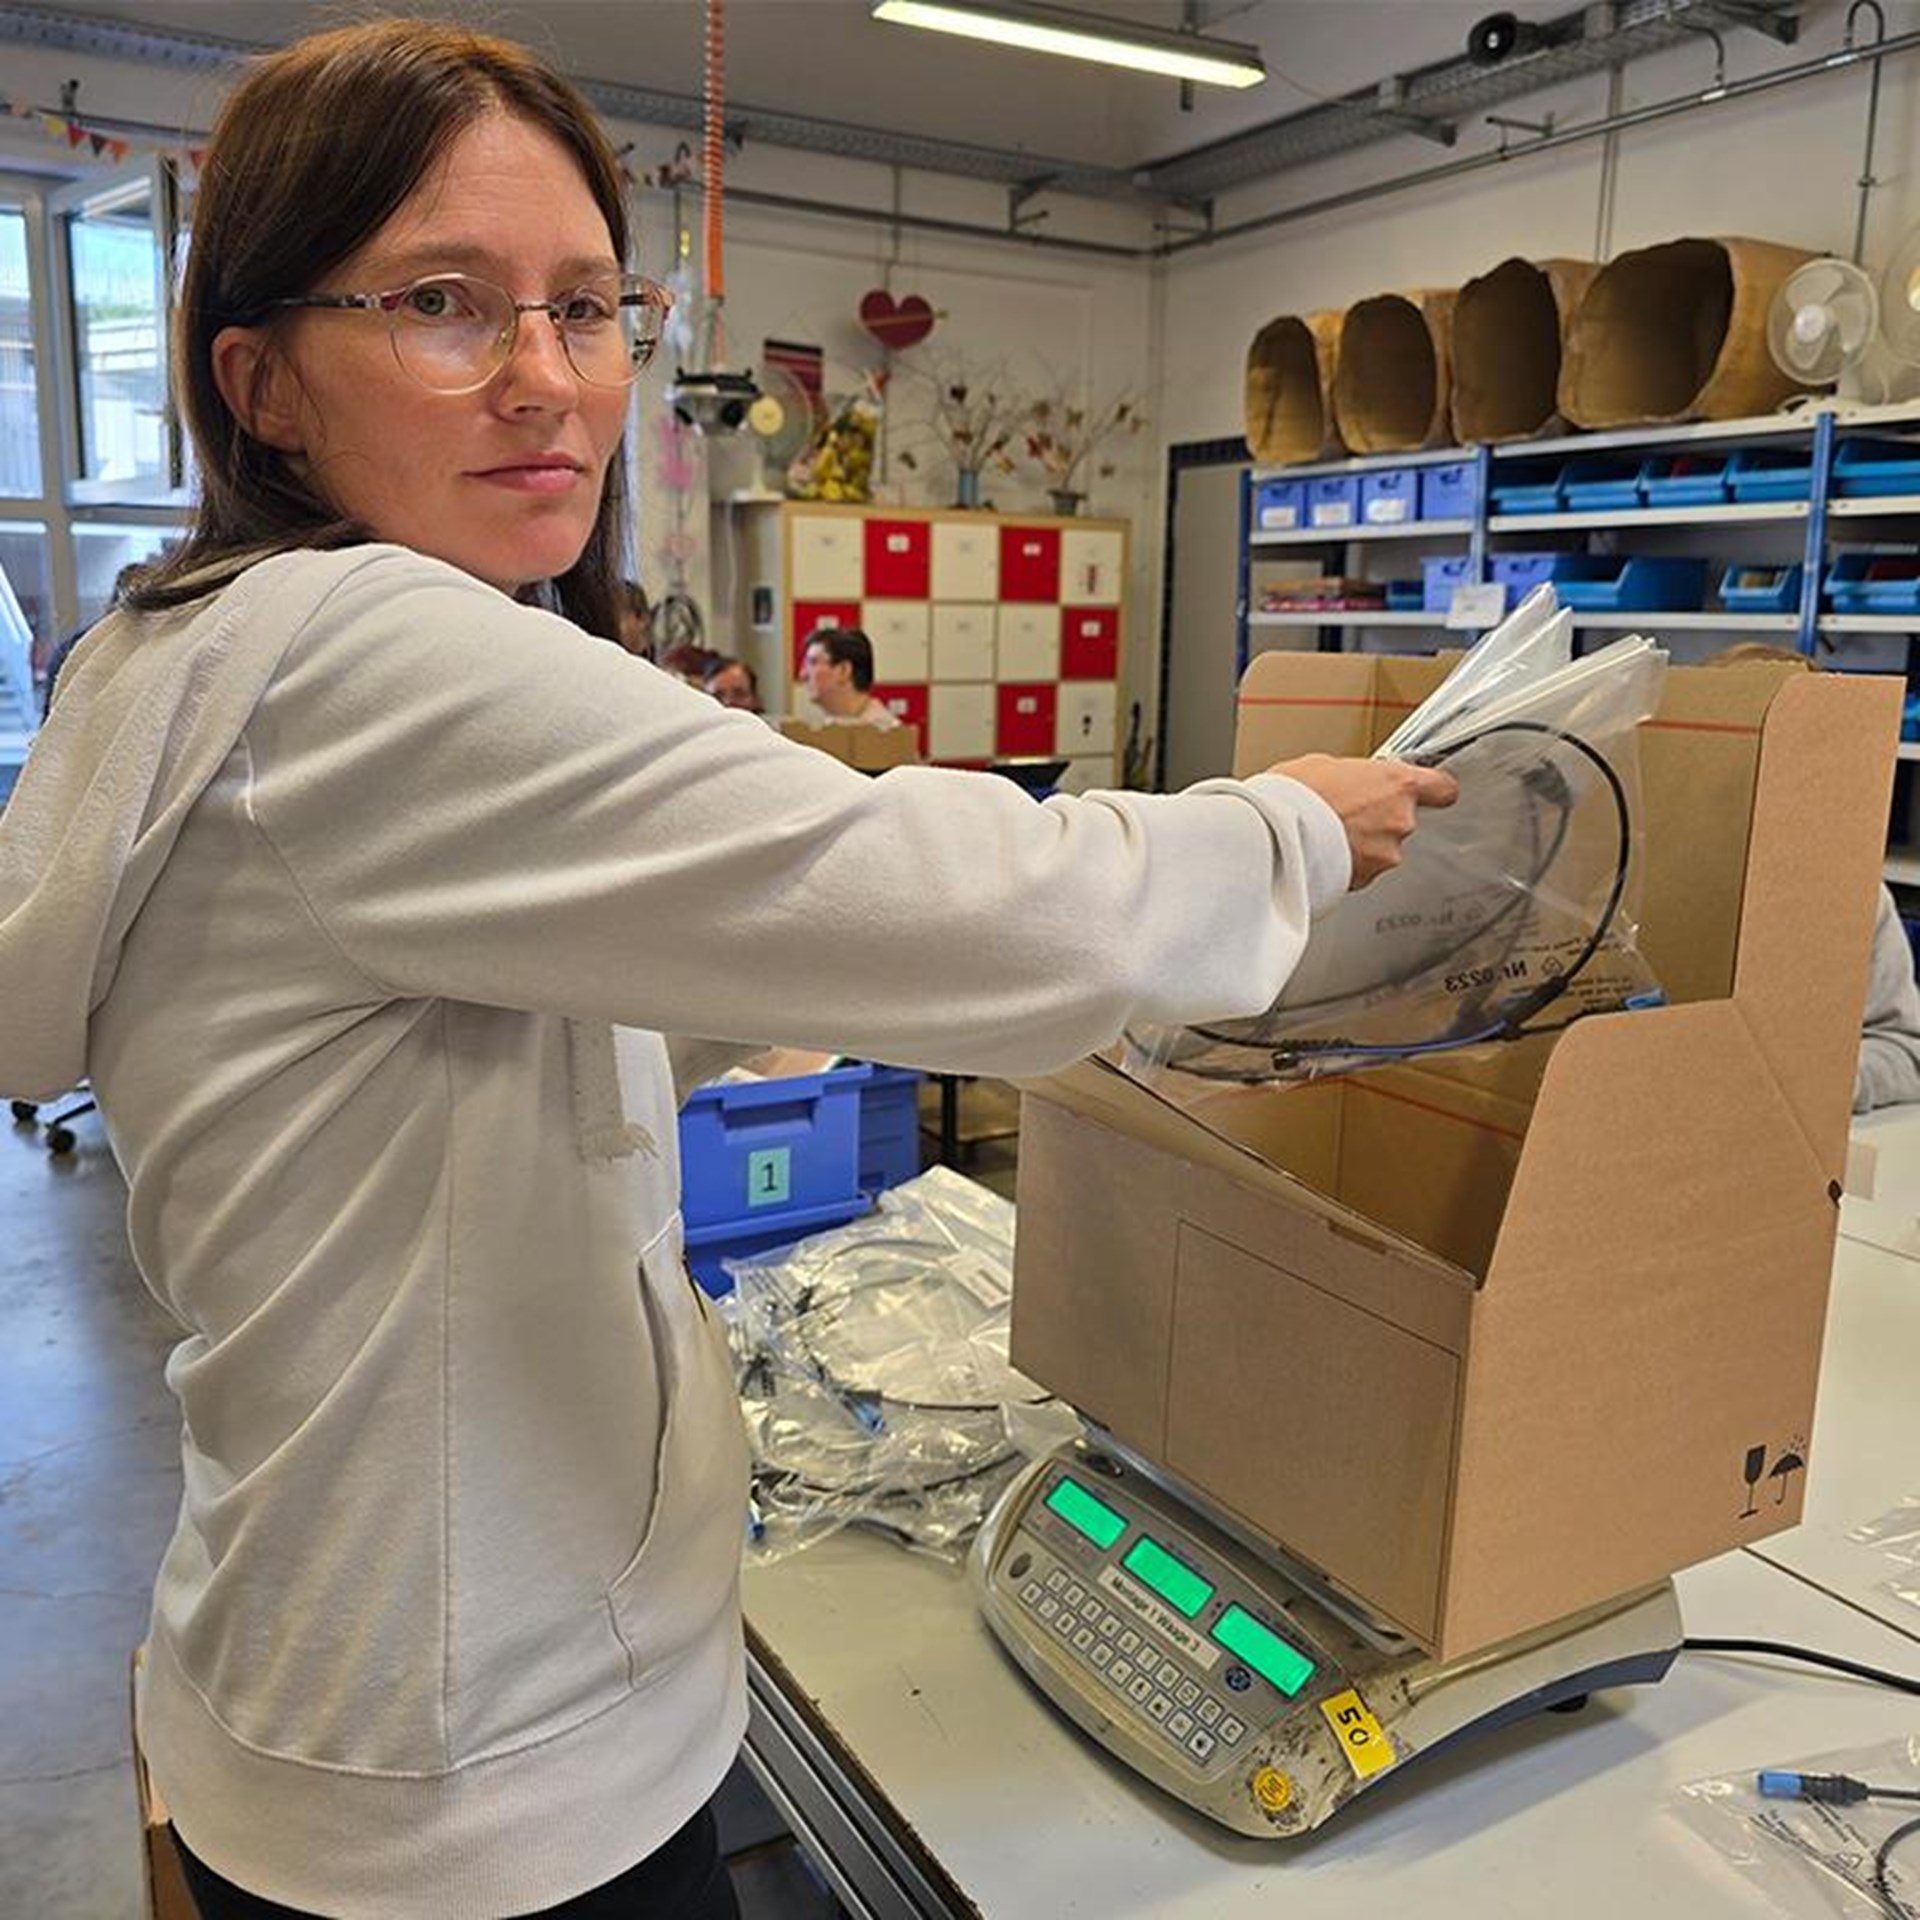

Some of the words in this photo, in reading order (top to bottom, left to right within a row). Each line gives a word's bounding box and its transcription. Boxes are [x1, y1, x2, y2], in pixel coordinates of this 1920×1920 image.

[761, 1162, 779, 1193] 1
[1156, 1612, 1190, 1646] Waage
[1336, 1706, 1370, 1747] 50
